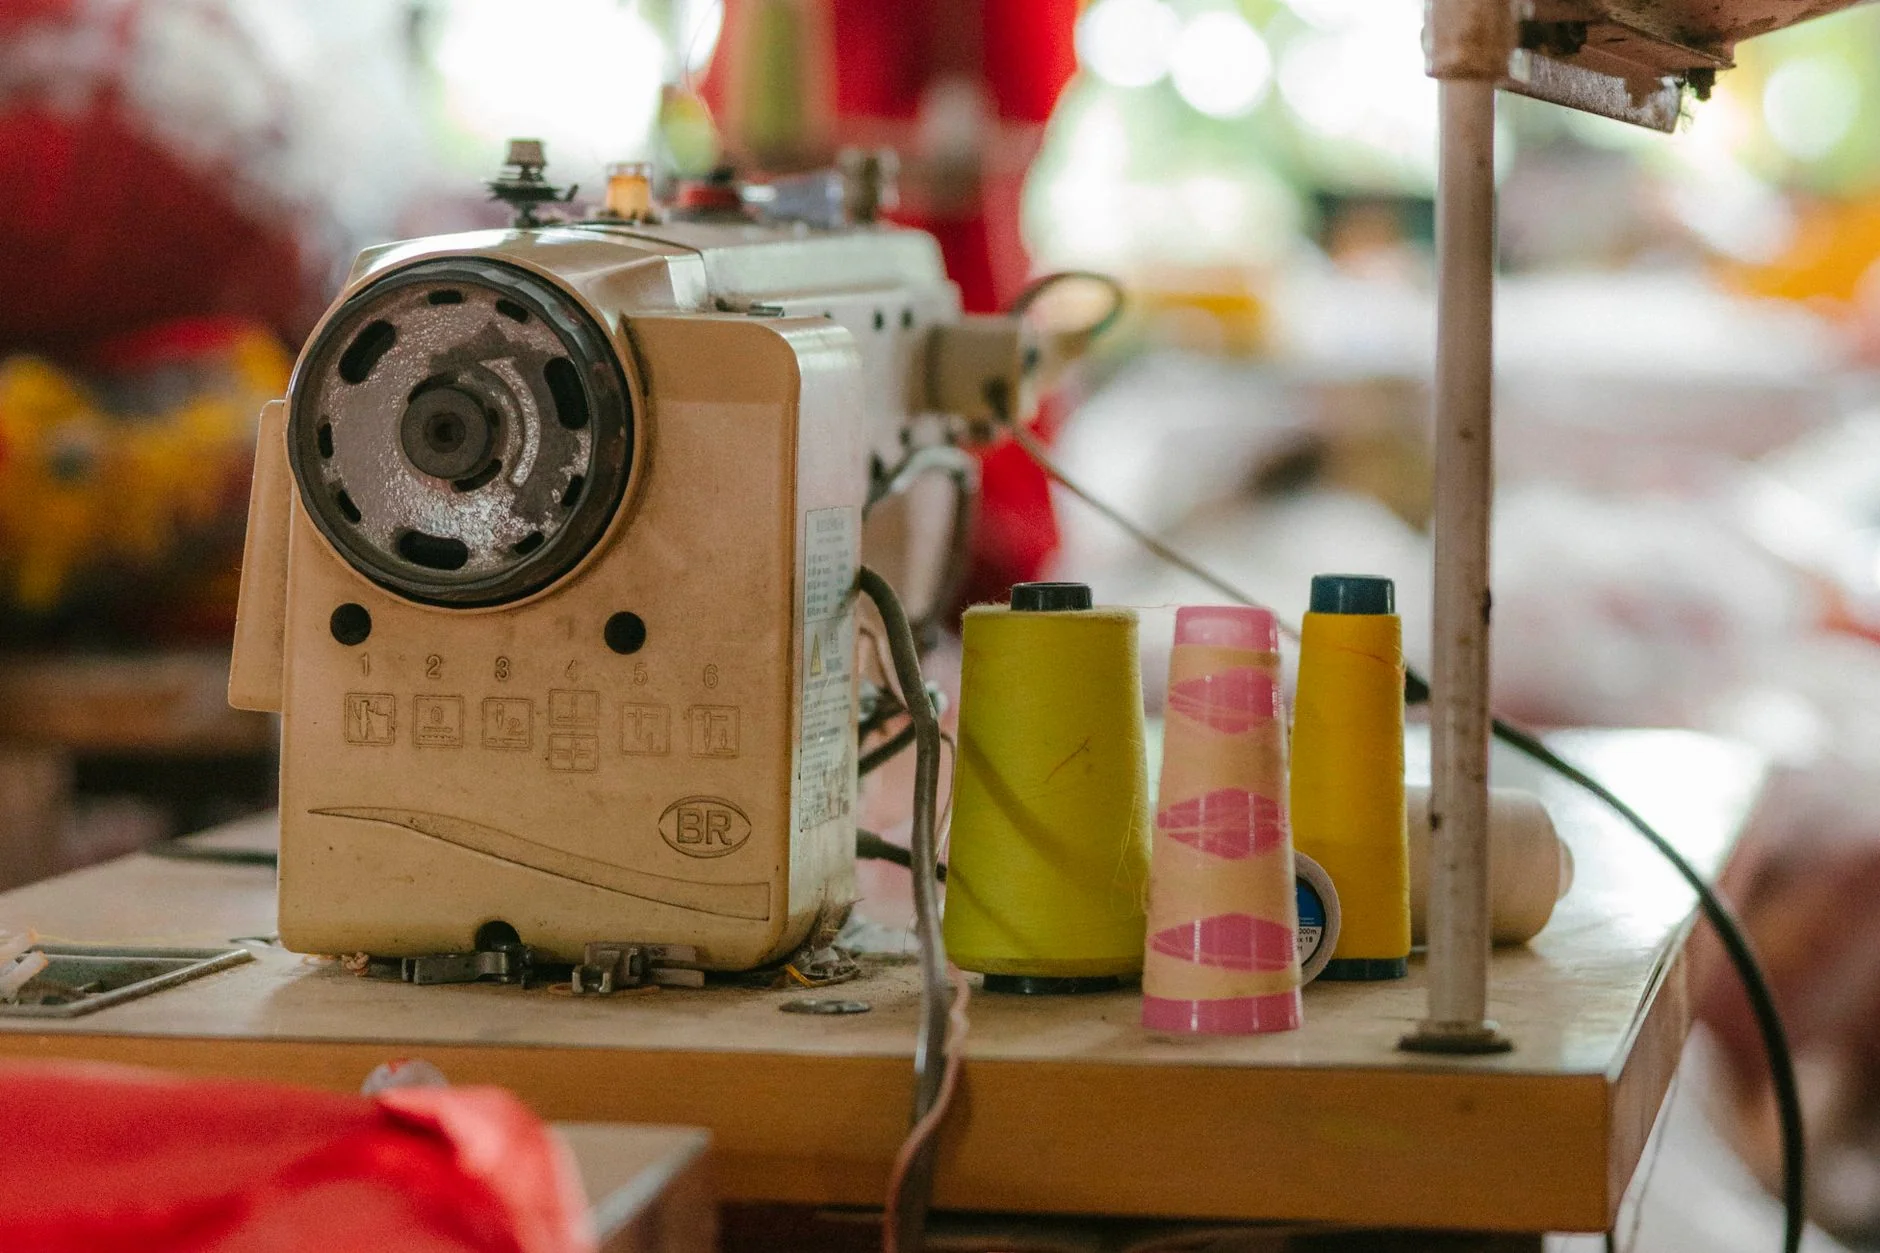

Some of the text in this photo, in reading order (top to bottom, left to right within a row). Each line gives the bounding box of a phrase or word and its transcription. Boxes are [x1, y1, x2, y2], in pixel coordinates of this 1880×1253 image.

[360, 652, 371, 677] 1
[425, 654, 442, 679] 2
[495, 655, 511, 681] 3
[633, 662, 649, 686] 5
[703, 663, 719, 689] 6
[676, 807, 732, 846] BR
